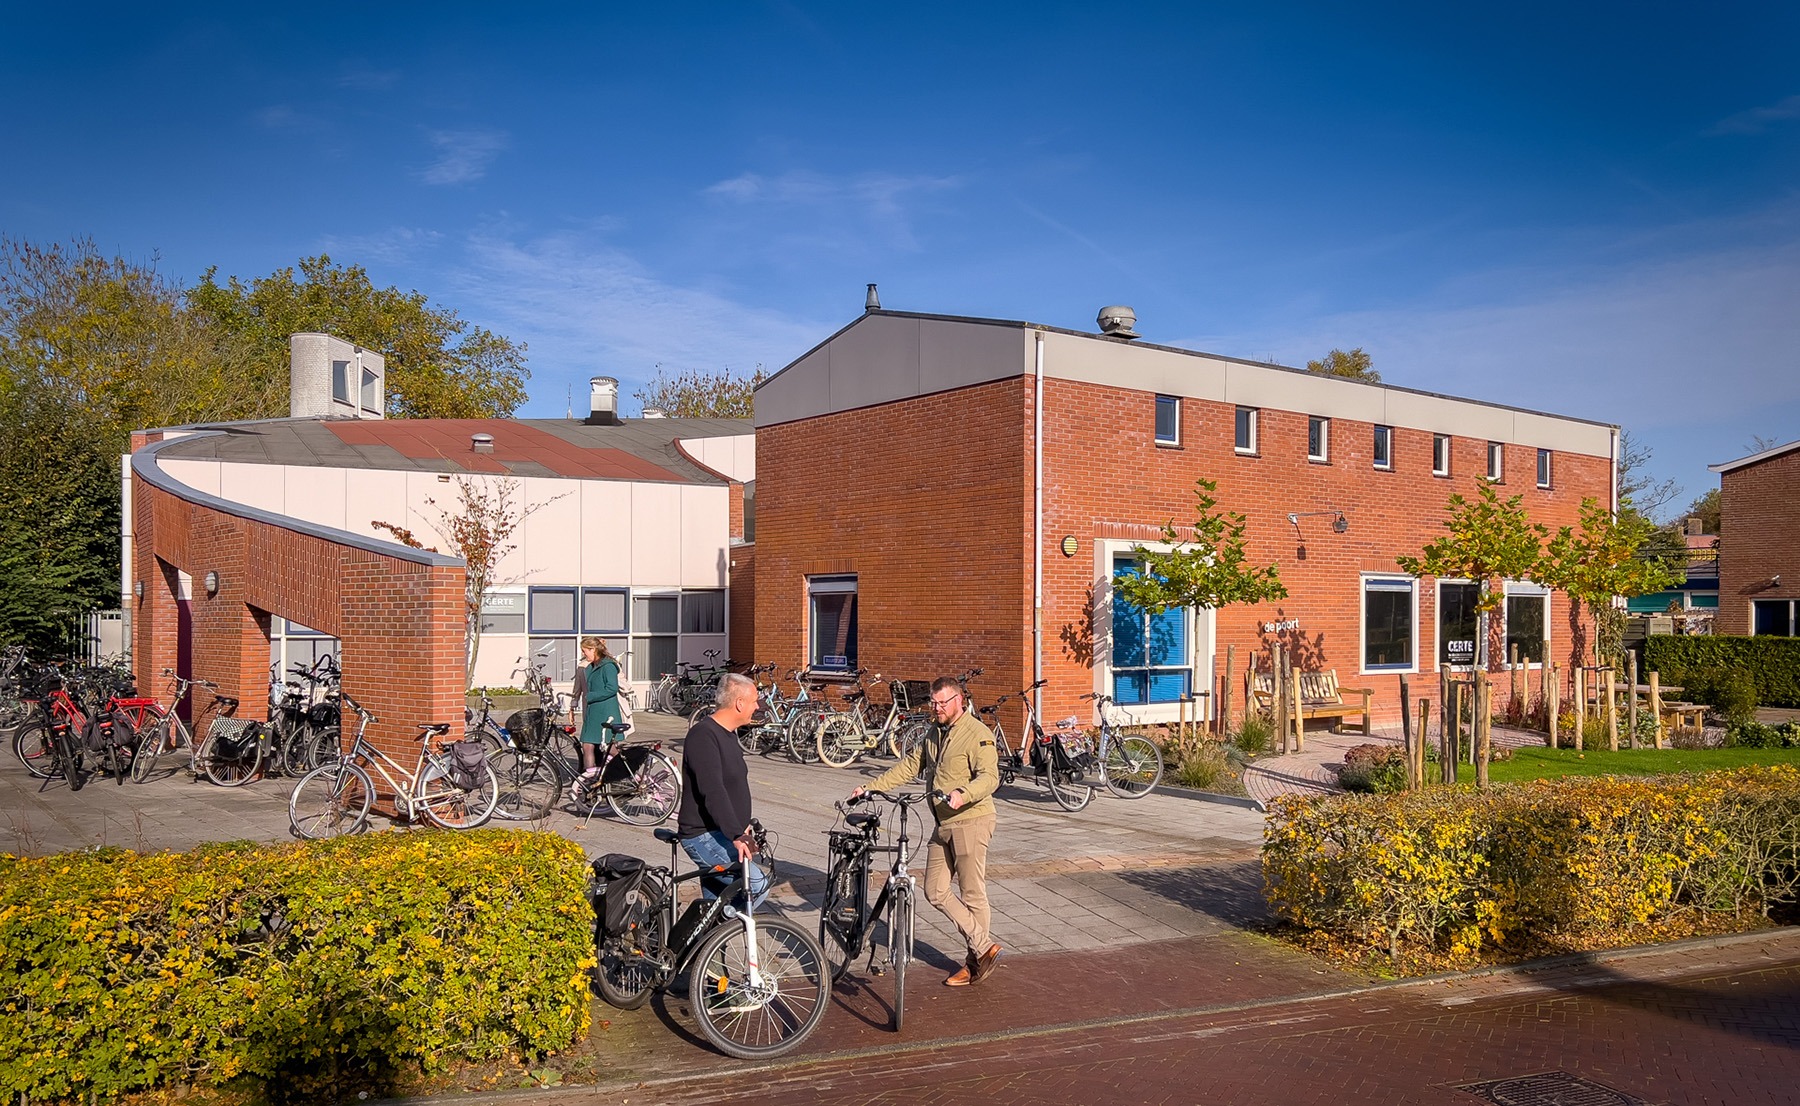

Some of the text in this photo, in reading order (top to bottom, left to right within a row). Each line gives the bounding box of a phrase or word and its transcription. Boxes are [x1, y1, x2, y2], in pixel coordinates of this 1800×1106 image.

[485, 597, 514, 606] CERTE
[1264, 617, 1299, 634] de poort
[1448, 640, 1473, 652] CERTE
